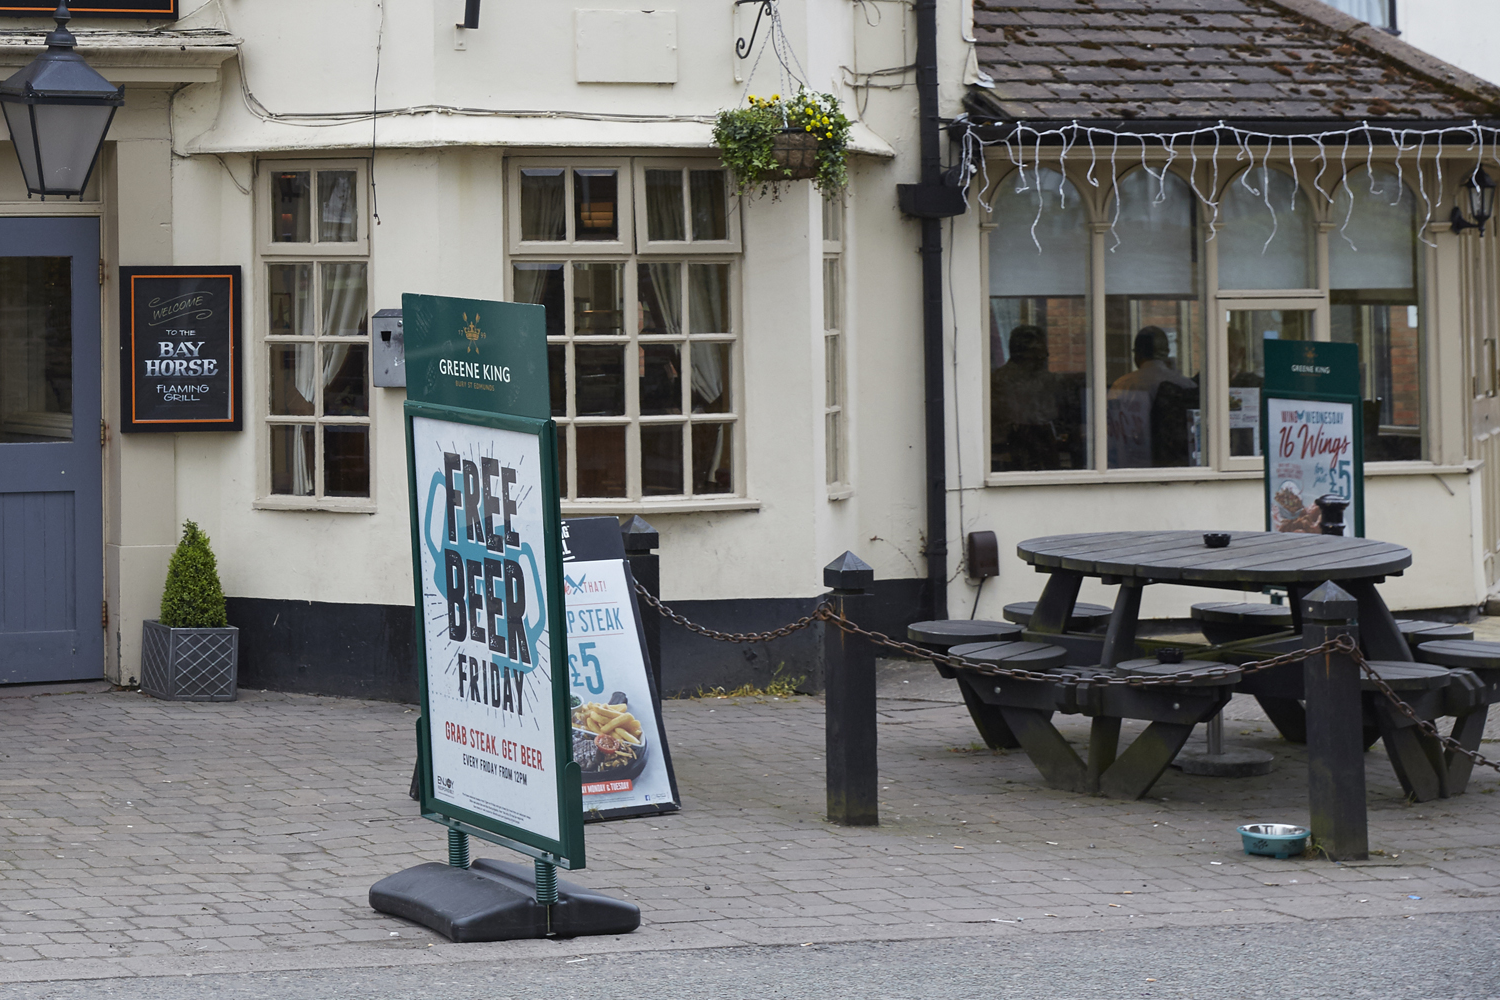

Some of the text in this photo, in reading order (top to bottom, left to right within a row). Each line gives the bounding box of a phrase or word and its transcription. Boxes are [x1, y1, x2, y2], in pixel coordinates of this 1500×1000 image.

[153, 296, 203, 320] WELCOME
[158, 341, 205, 358] BAY
[145, 359, 219, 376] HORSE
[439, 359, 511, 383] GREENE KING
[1291, 364, 1330, 374] GREENE KING
[156, 384, 209, 394] FLAMING
[474, 382, 495, 392] EDMUNDS
[163, 393, 200, 402] GRILL
[1306, 411, 1344, 424] WEDNESDAY
[1279, 423, 1351, 469] 16 Wings
[443, 451, 520, 553] FREE
[583, 581, 607, 594] THAT!
[444, 548, 531, 665] BEER
[578, 608, 624, 632] STEAK
[568, 642, 604, 695] £5
[458, 653, 524, 716] FRIDAY
[445, 720, 544, 772] GRAB STEAK. GET BEER.
[462, 754, 528, 786] EVERY FRIDAY FROM 12PM
[438, 775, 454, 789] ENJOY
[588, 784, 606, 794] MONDAY
[610, 782, 630, 791] TUESDAY
